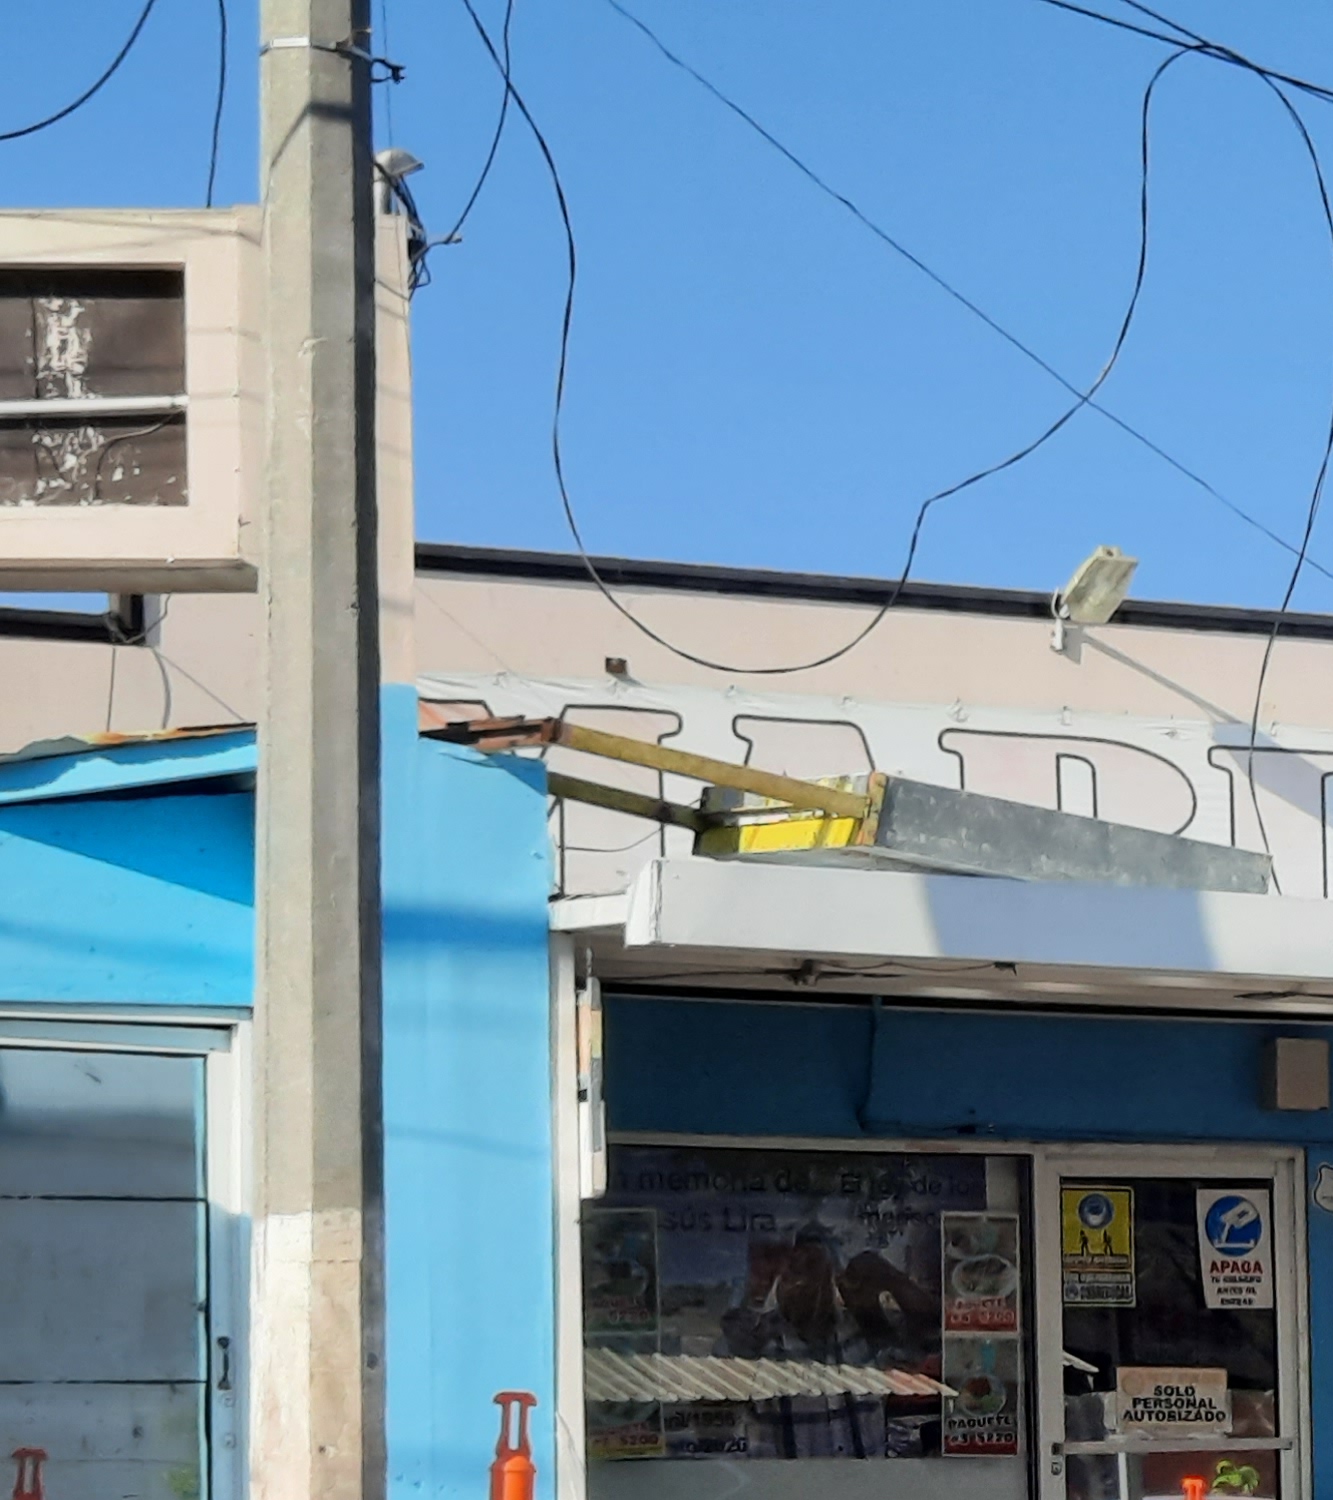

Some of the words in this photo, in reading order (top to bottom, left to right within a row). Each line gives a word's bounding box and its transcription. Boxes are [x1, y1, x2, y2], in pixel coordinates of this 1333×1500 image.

[1209, 1259, 1264, 1275] APAGA
[1153, 1384, 1196, 1397] SOLO
[1132, 1397, 1217, 1409] PERSONAL
[1123, 1409, 1227, 1423] AUTORIZADO
